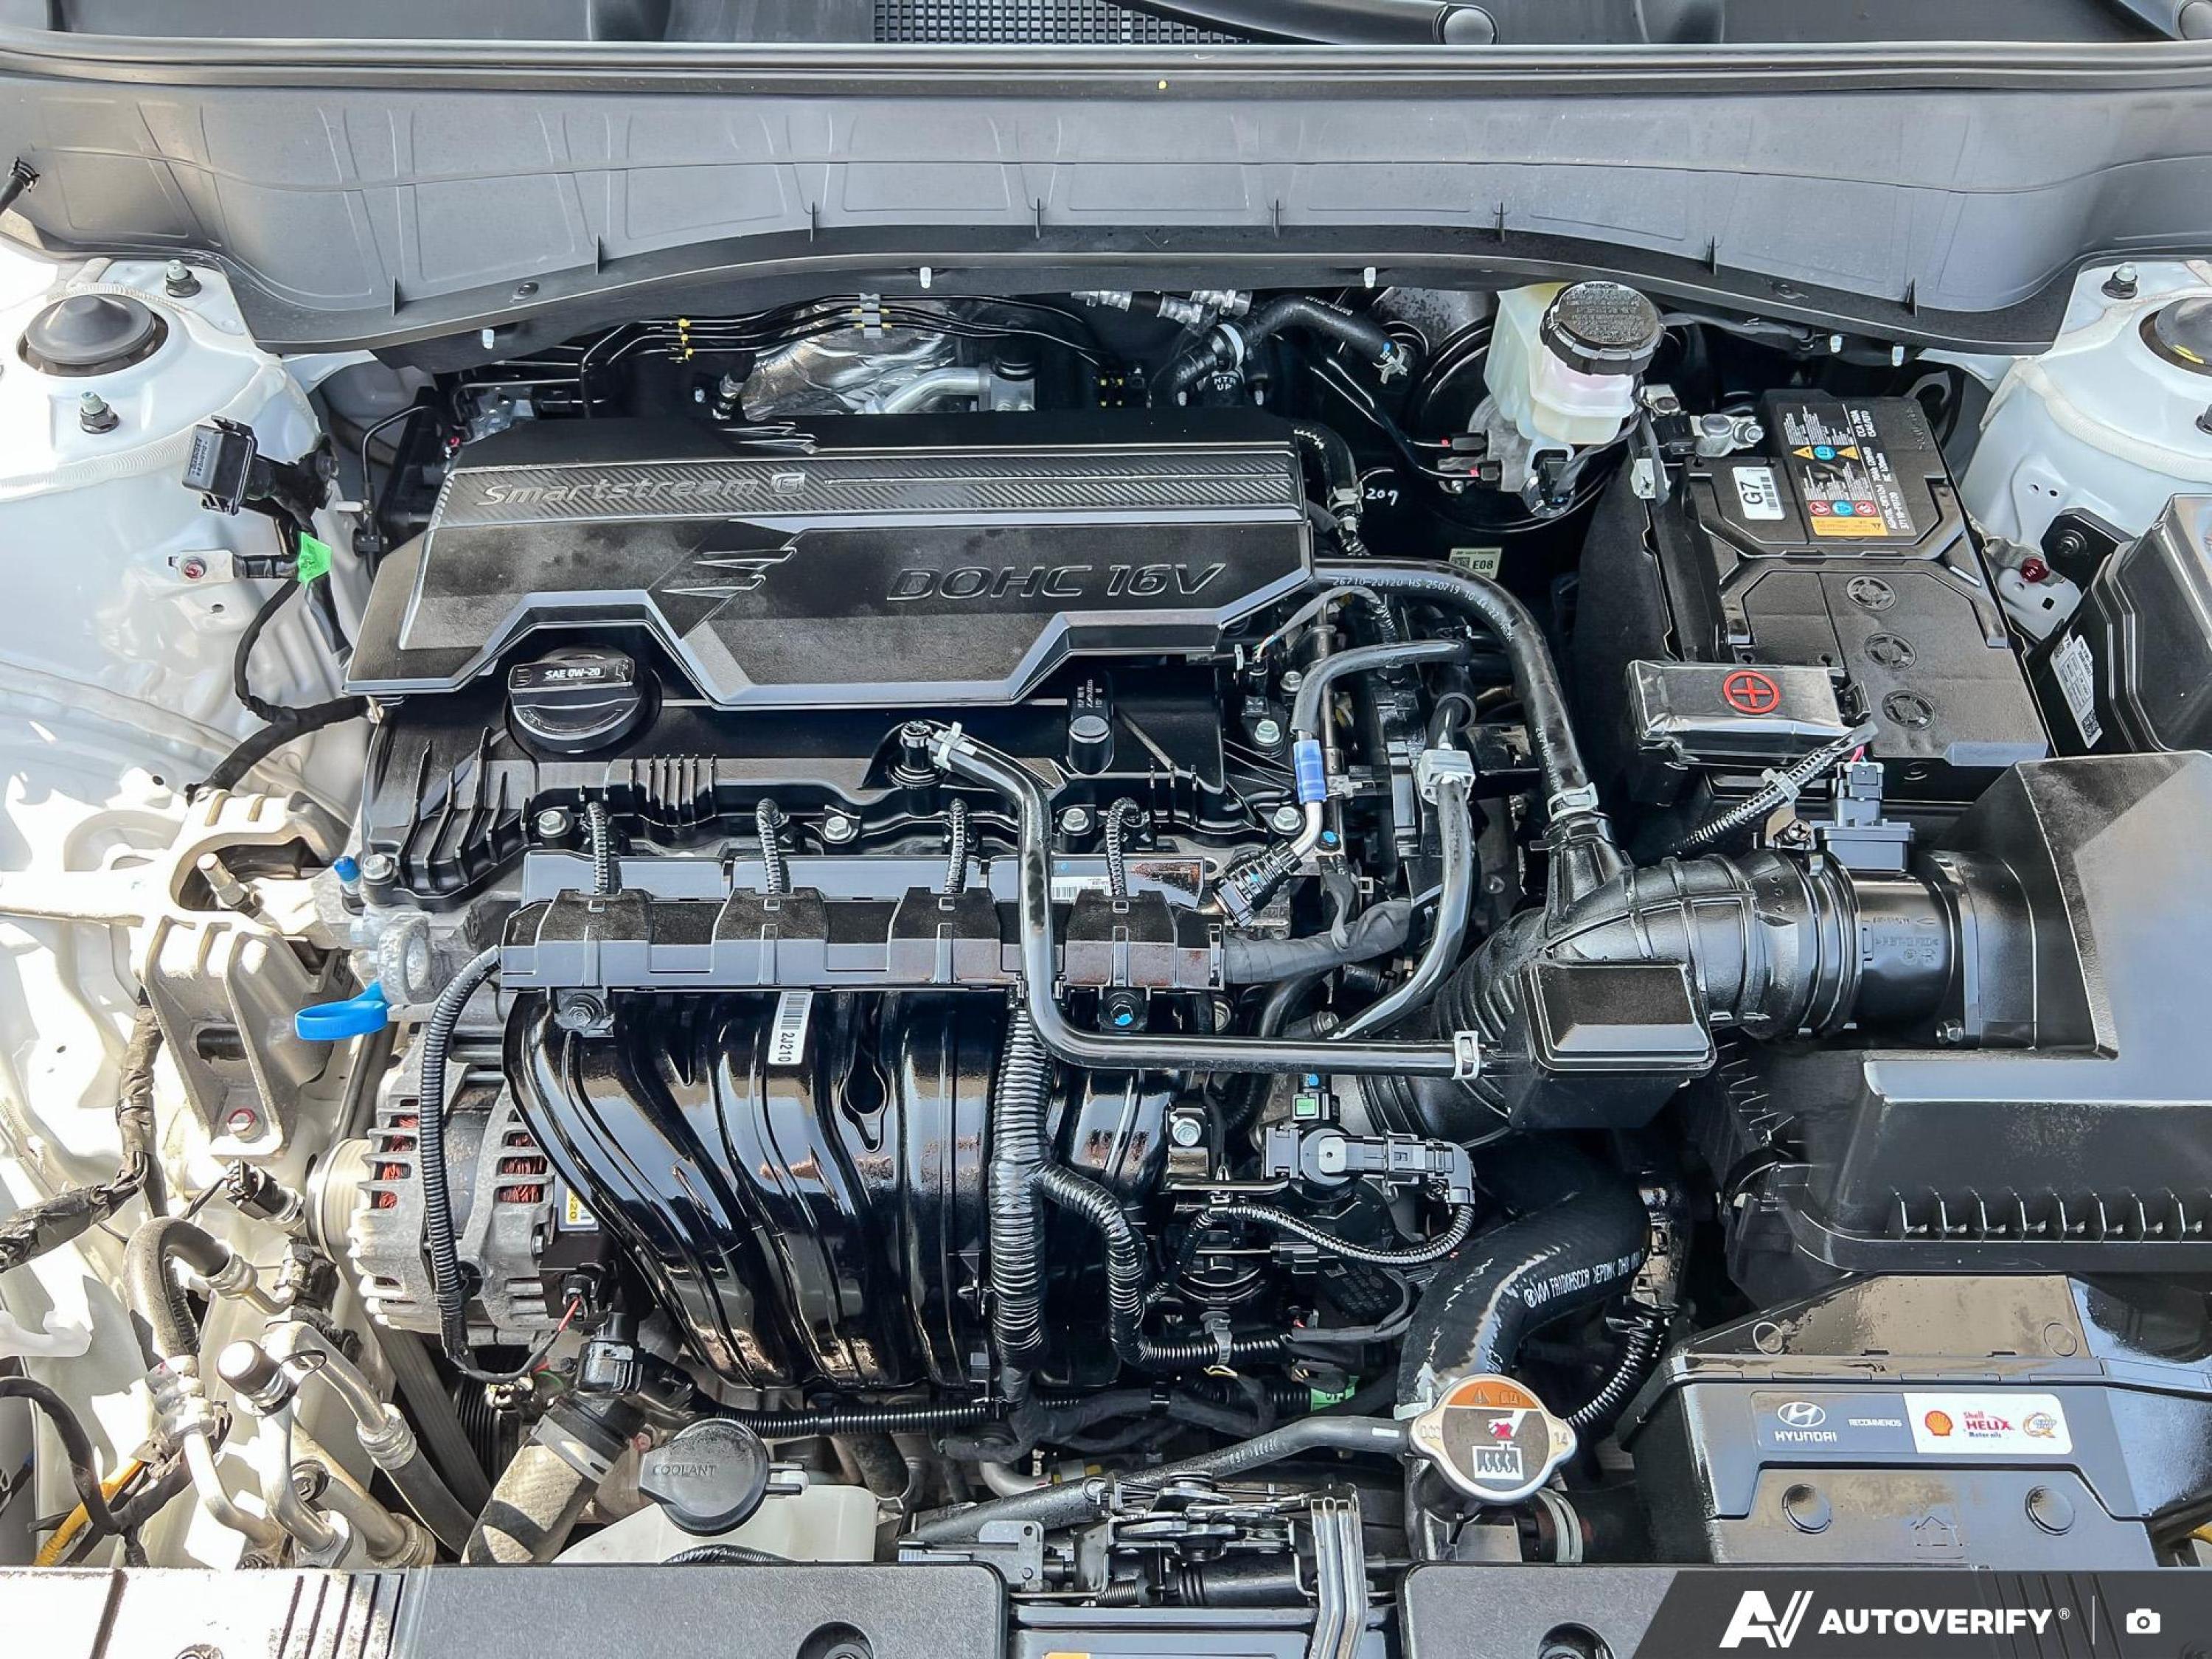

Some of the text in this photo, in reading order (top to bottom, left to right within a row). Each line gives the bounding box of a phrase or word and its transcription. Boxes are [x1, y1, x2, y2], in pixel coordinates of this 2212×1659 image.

[477, 478, 759, 506] Smartstream
[1739, 481, 1764, 504] G7
[1472, 559, 1494, 570] E08
[886, 563, 1227, 601] DOHC 16V
[544, 667, 601, 679] SAE 0W-20
[778, 1032, 796, 1062] 2J210
[1963, 1410, 1984, 1419] Shell
[1966, 1420, 2014, 1430] HELIX
[1775, 1430, 1837, 1443] HYUNDAI
[653, 1464, 717, 1476] COOLANT
